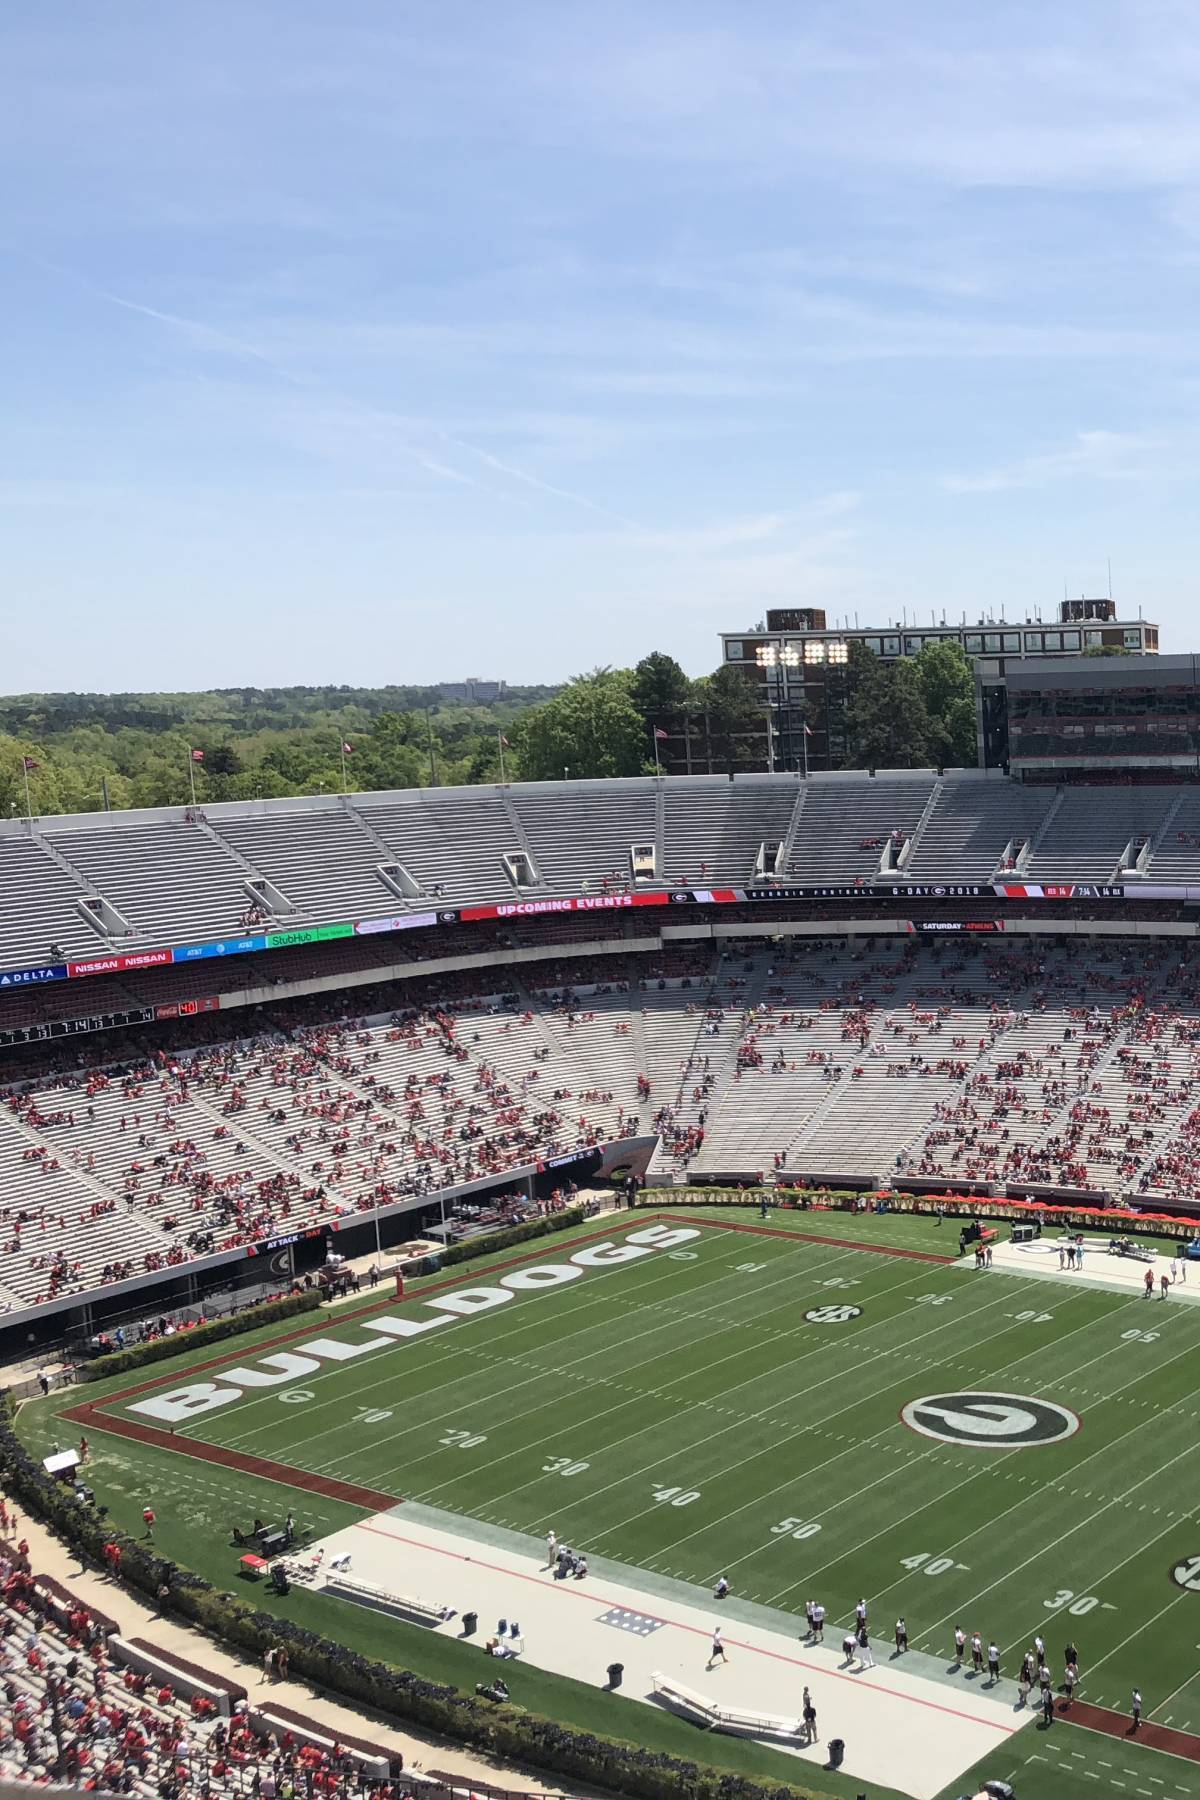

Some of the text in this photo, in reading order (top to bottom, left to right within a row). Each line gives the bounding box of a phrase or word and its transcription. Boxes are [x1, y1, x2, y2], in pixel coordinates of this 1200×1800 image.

[496, 896, 632, 915] UPCOMING EVENTS
[272, 932, 312, 945] StubHub
[75, 954, 166, 973] NISSAN NISSAN
[14, 970, 54, 982] DELTA
[181, 1003, 195, 1012] 40
[62, 1020, 87, 1032] 7:14
[267, 1234, 298, 1249] ATTACK
[736, 1262, 763, 1272] 10
[822, 1277, 862, 1290] 20
[915, 1293, 953, 1306] 30
[806, 1305, 860, 1323] SEC
[1014, 1310, 1053, 1322] 40
[124, 1224, 701, 1422] BULLDOGS
[1121, 1328, 1161, 1343] 50
[352, 1408, 393, 1423] 10
[438, 1432, 488, 1448] 20
[542, 1458, 589, 1476] 30
[651, 1486, 700, 1506] 40
[769, 1517, 822, 1540] 50
[899, 1552, 955, 1575] 40
[1043, 1589, 1099, 1615] 30
